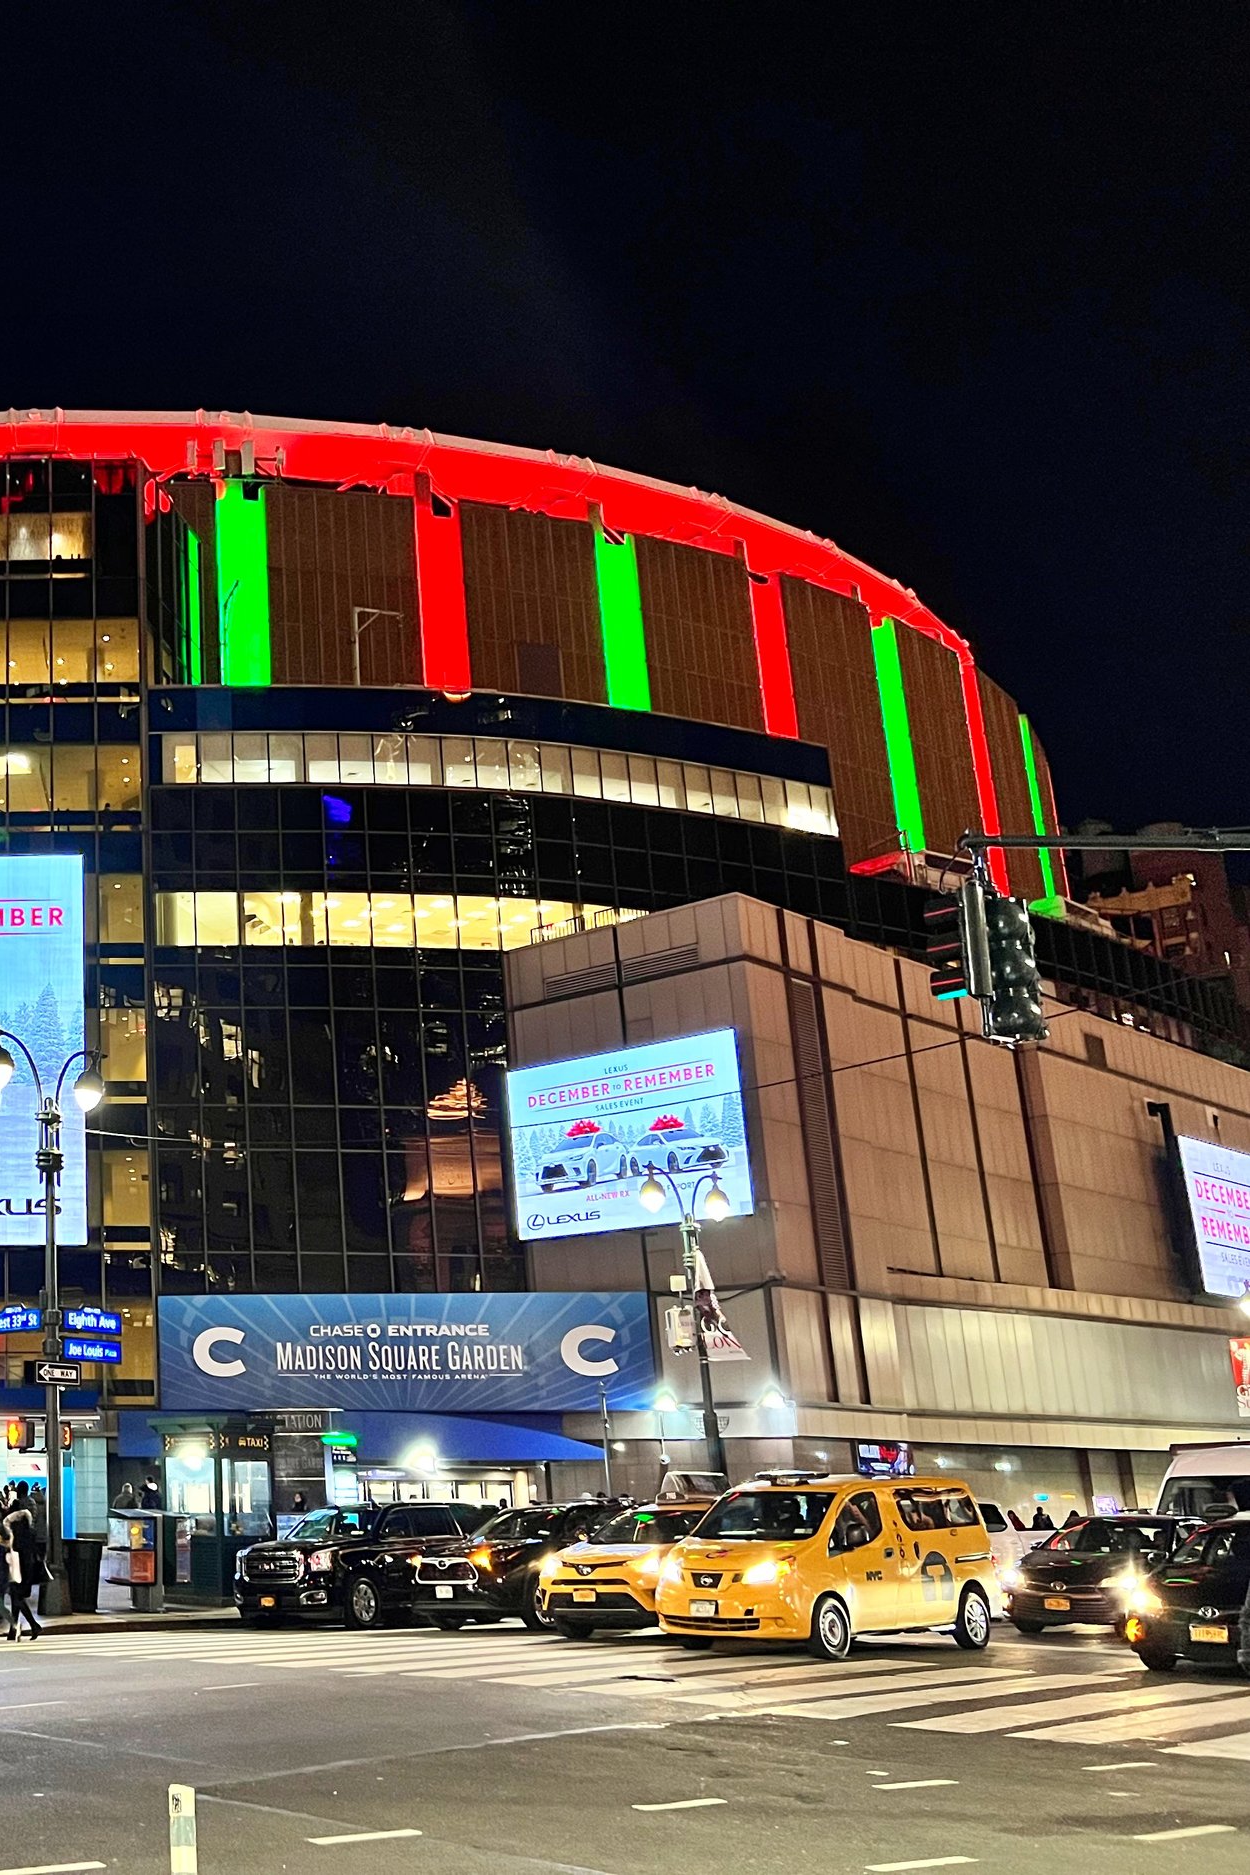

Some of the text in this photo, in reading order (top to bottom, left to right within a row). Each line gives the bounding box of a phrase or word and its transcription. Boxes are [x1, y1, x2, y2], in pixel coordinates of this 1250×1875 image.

[604, 1064, 628, 1075] LEXUS
[527, 1063, 715, 1109] DECEMBER TO REMEMBER
[596, 1097, 643, 1112] SALES EVENT
[586, 1189, 630, 1202] ALL-NEW RX
[1194, 1179, 1250, 1210] DECEMBE
[547, 1210, 600, 1225] LEXUS
[12, 1315, 26, 1328] 33rd
[28, 1313, 37, 1326] St
[68, 1313, 116, 1330] Eighth Ave
[309, 1324, 489, 1337] CHASE ENTRANCE
[68, 1343, 82, 1356] Joe
[84, 1344, 104, 1357] Louis
[193, 1326, 247, 1377] C
[560, 1325, 619, 1377] C
[43, 1369, 73, 1378] ONE WAY
[246, 1437, 264, 1447] TAXI
[865, 1571, 883, 1581] NYC
